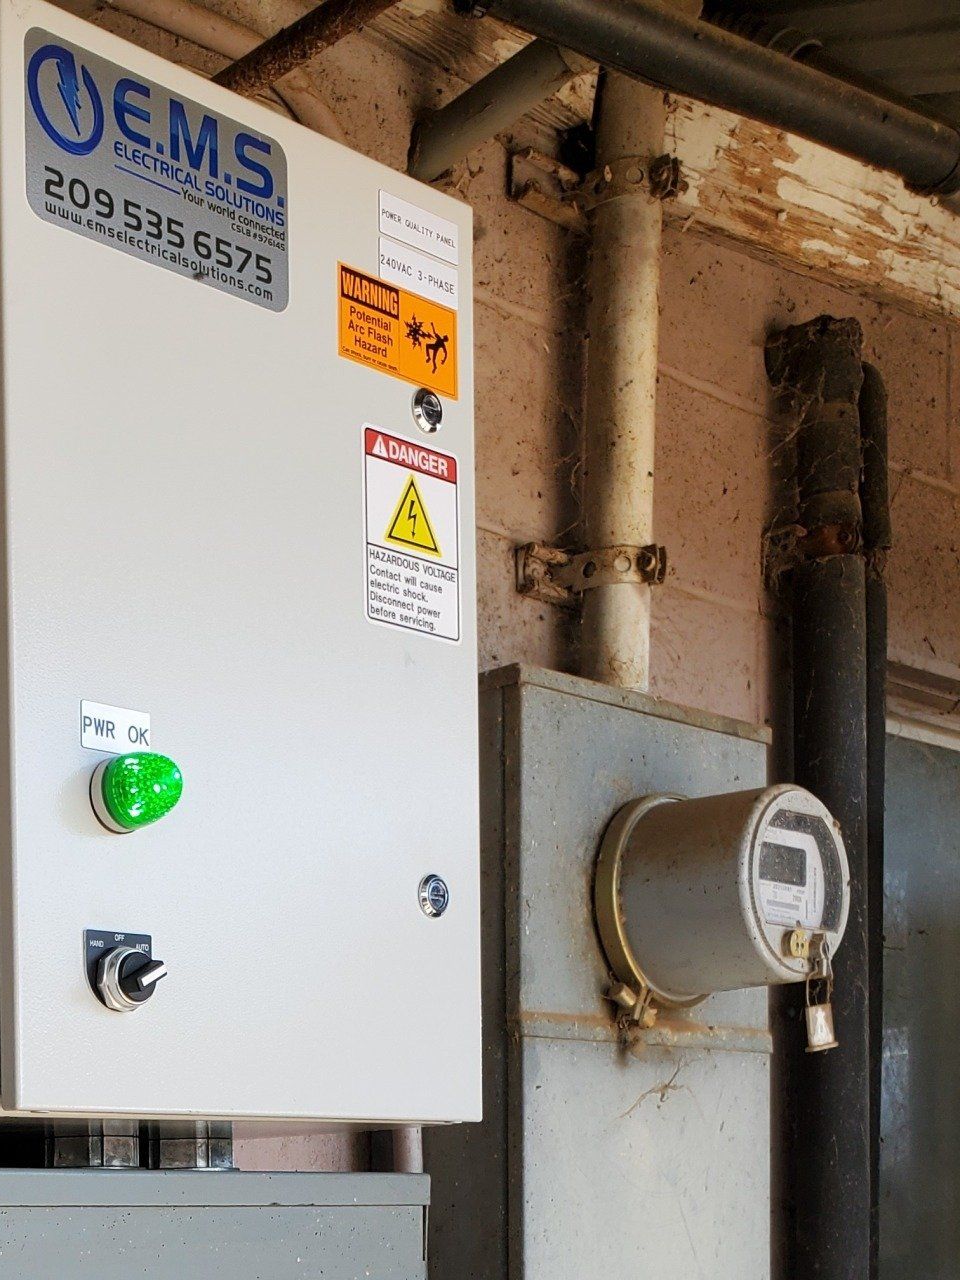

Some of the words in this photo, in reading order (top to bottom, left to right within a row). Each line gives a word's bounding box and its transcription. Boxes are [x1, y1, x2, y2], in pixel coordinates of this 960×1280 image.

[113, 78, 284, 208] E.M.S.
[114, 141, 201, 192] ELECTRICAL
[205, 181, 284, 228] SOLUTIONS
[44, 166, 114, 219] 209
[124, 199, 185, 249] 535
[193, 230, 272, 284] 6575
[181, 187, 204, 207] Your
[207, 201, 235, 220] world
[238, 215, 285, 240] connected
[381, 208, 402, 225] POWER
[405, 219, 433, 238] QUALITY
[436, 233, 455, 249] PANEL
[231, 223, 251, 237] CSLB
[45, 201, 273, 301] www.emselectricalsolutions.com
[380, 254, 413, 277] 240VAC
[417, 270, 455, 295] 3-PHASE
[342, 270, 399, 315] WARNING
[347, 319, 365, 337] Arc
[368, 325, 393, 347] Flash
[349, 306, 392, 332] Potential
[354, 334, 387, 358] Hazard
[388, 441, 448, 477] DANGER
[369, 549, 420, 572] HAZARDOUS
[423, 564, 456, 583] VOLTAGE
[369, 564, 401, 582] Contact
[404, 573, 417, 586] will
[420, 580, 442, 594] cause
[370, 579, 400, 595] electric
[403, 587, 428, 603] shock.
[370, 591, 414, 612] Disconnect
[417, 605, 441, 619] power
[370, 604, 396, 620] before
[399, 611, 437, 631] servicing.
[83, 715, 115, 739] PWR
[127, 725, 150, 747] OK
[114, 933, 125, 941] OFF
[135, 943, 149, 951] AUTO
